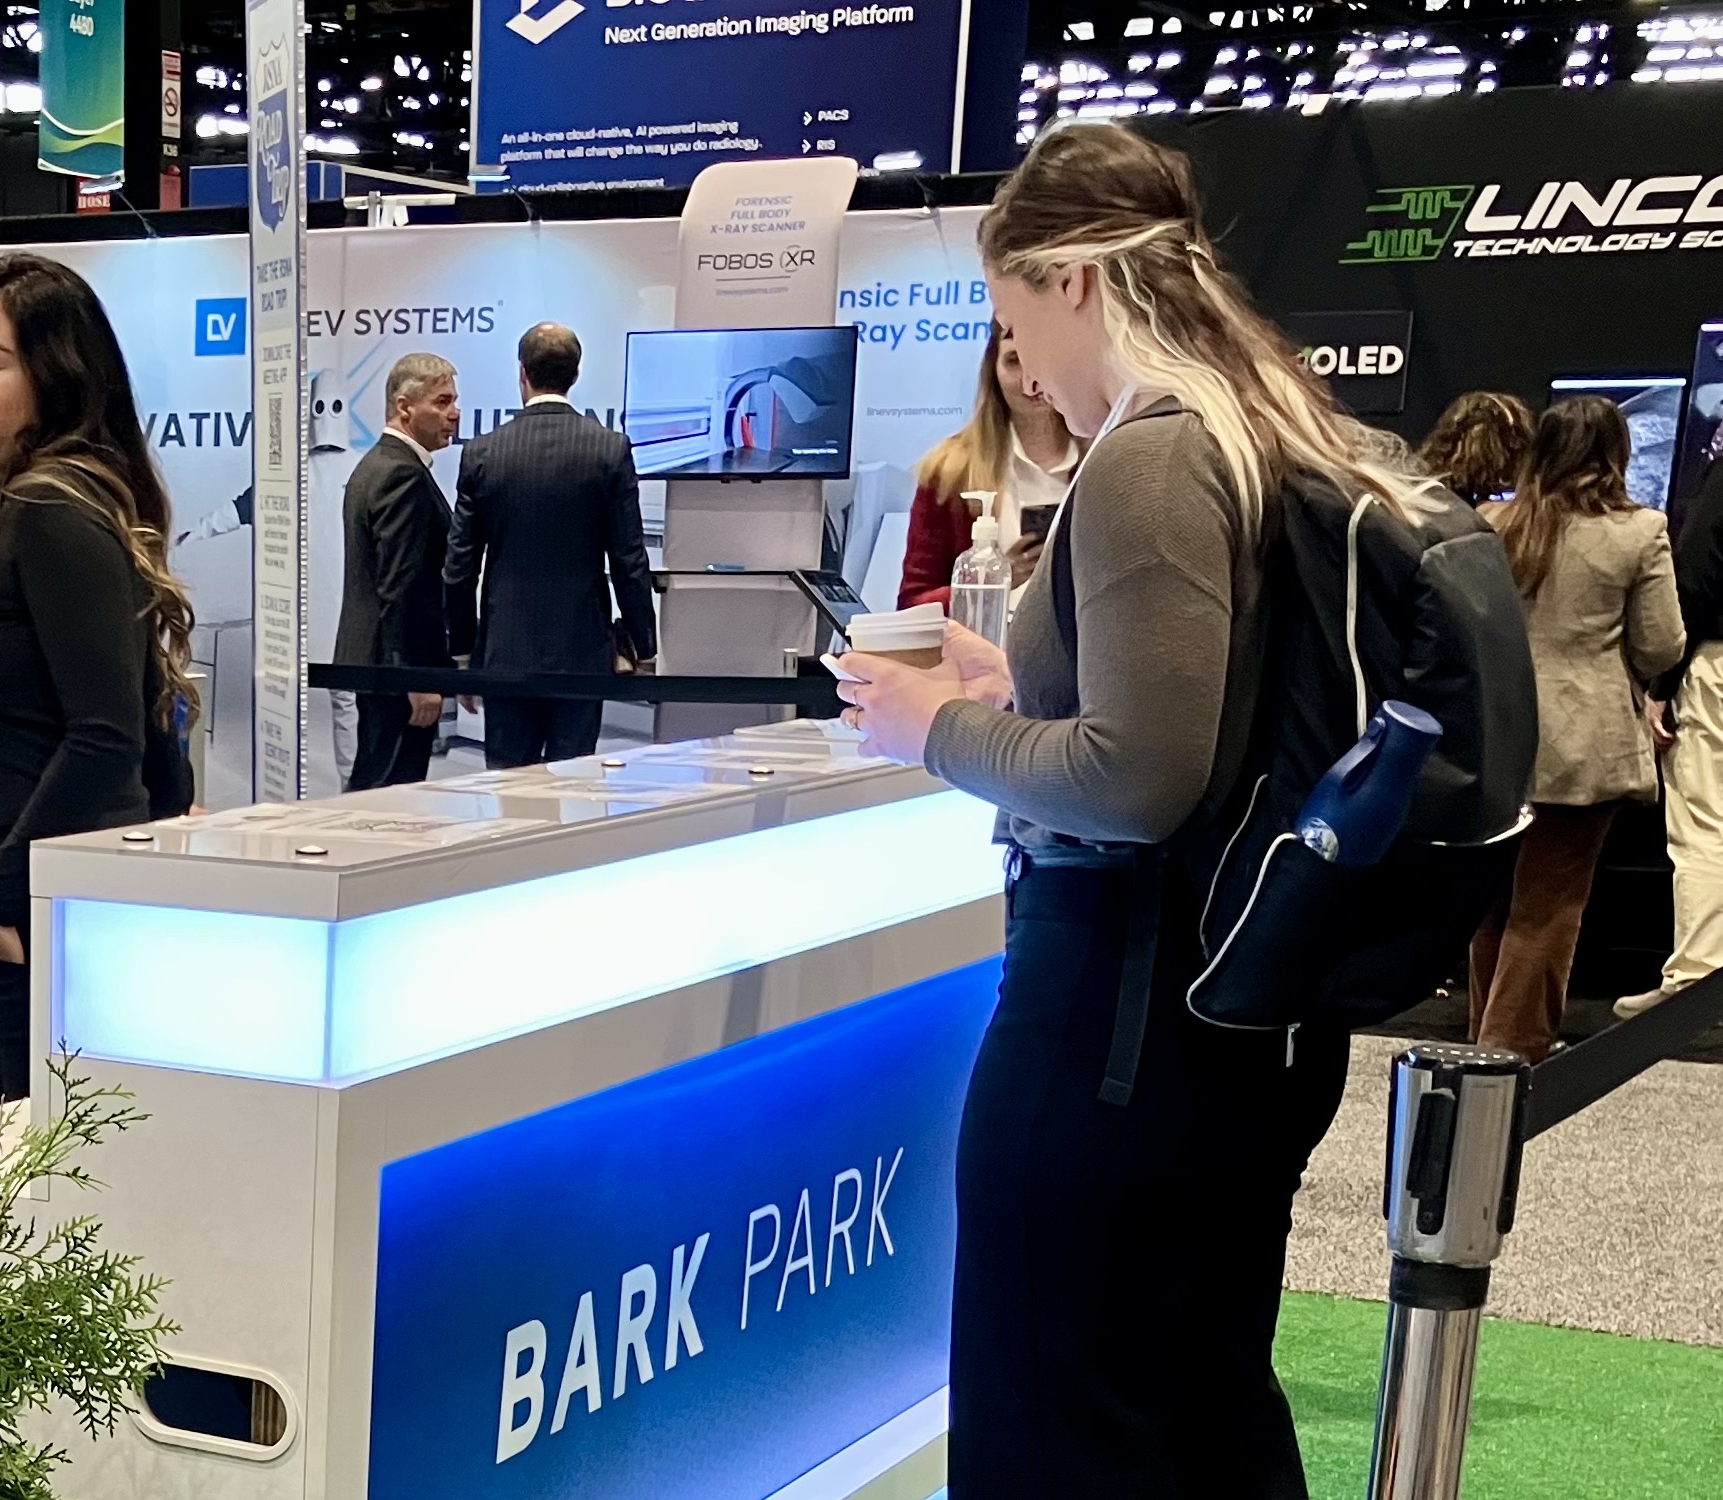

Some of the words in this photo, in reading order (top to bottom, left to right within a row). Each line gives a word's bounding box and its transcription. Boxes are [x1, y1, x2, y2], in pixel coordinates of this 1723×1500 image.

[604, 25, 648, 45] Next
[650, 16, 752, 41] Generation
[755, 10, 829, 36] Imaging
[833, 4, 914, 27] Platform
[817, 109, 849, 122] PACS
[501, 133, 516, 145] An
[517, 131, 565, 144] all-in-one
[565, 126, 634, 141] cloud-native,
[648, 122, 696, 138] powered
[696, 119, 739, 135] imaging
[500, 150, 543, 164] platform
[544, 148, 566, 160] that
[566, 147, 584, 158] will
[585, 145, 624, 159] change
[625, 144, 644, 155] the
[644, 142, 668, 156] way
[669, 142, 691, 155] you
[692, 140, 708, 151] do
[816, 139, 836, 151] RIS
[734, 195, 793, 206] FORENSIC
[730, 210, 756, 220] FULL
[758, 208, 792, 219] BODY
[710, 223, 749, 234] X-RAY
[751, 220, 806, 233] SCANNER
[1452, 231, 1676, 259] TECHNOLOGY
[697, 252, 774, 271] FOBOS
[783, 248, 816, 269] XR
[839, 282, 900, 308] nsic
[908, 280, 960, 306] Full
[354, 306, 495, 335] SYSTEMS
[852, 320, 908, 351] Ray
[866, 406, 963, 418] linevsystems.com
[495, 1232, 711, 1465] BARK
[740, 1146, 904, 1331] PARK
